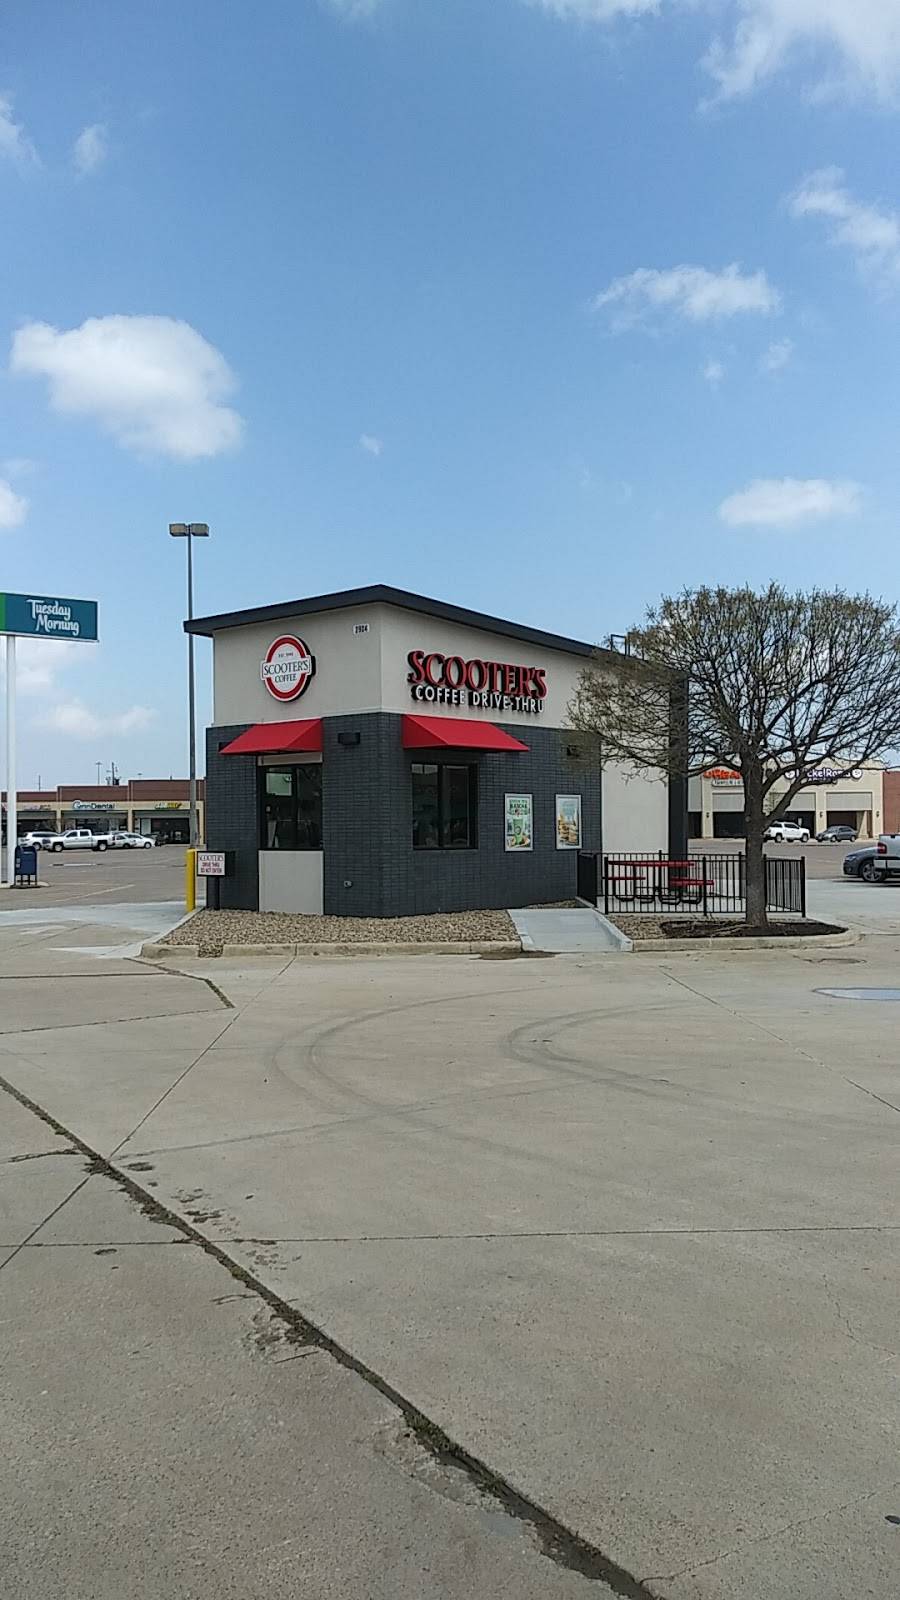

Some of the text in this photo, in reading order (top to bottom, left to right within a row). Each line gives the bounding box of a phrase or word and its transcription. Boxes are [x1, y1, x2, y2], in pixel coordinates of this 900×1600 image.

[26, 599, 71, 620] Tuesday
[35, 614, 79, 636] Morning
[263, 660, 309, 676] SCOOTER'S
[274, 673, 298, 683] COFFEE
[407, 650, 547, 699] SCOOTER'S
[415, 685, 466, 704] COFFEE
